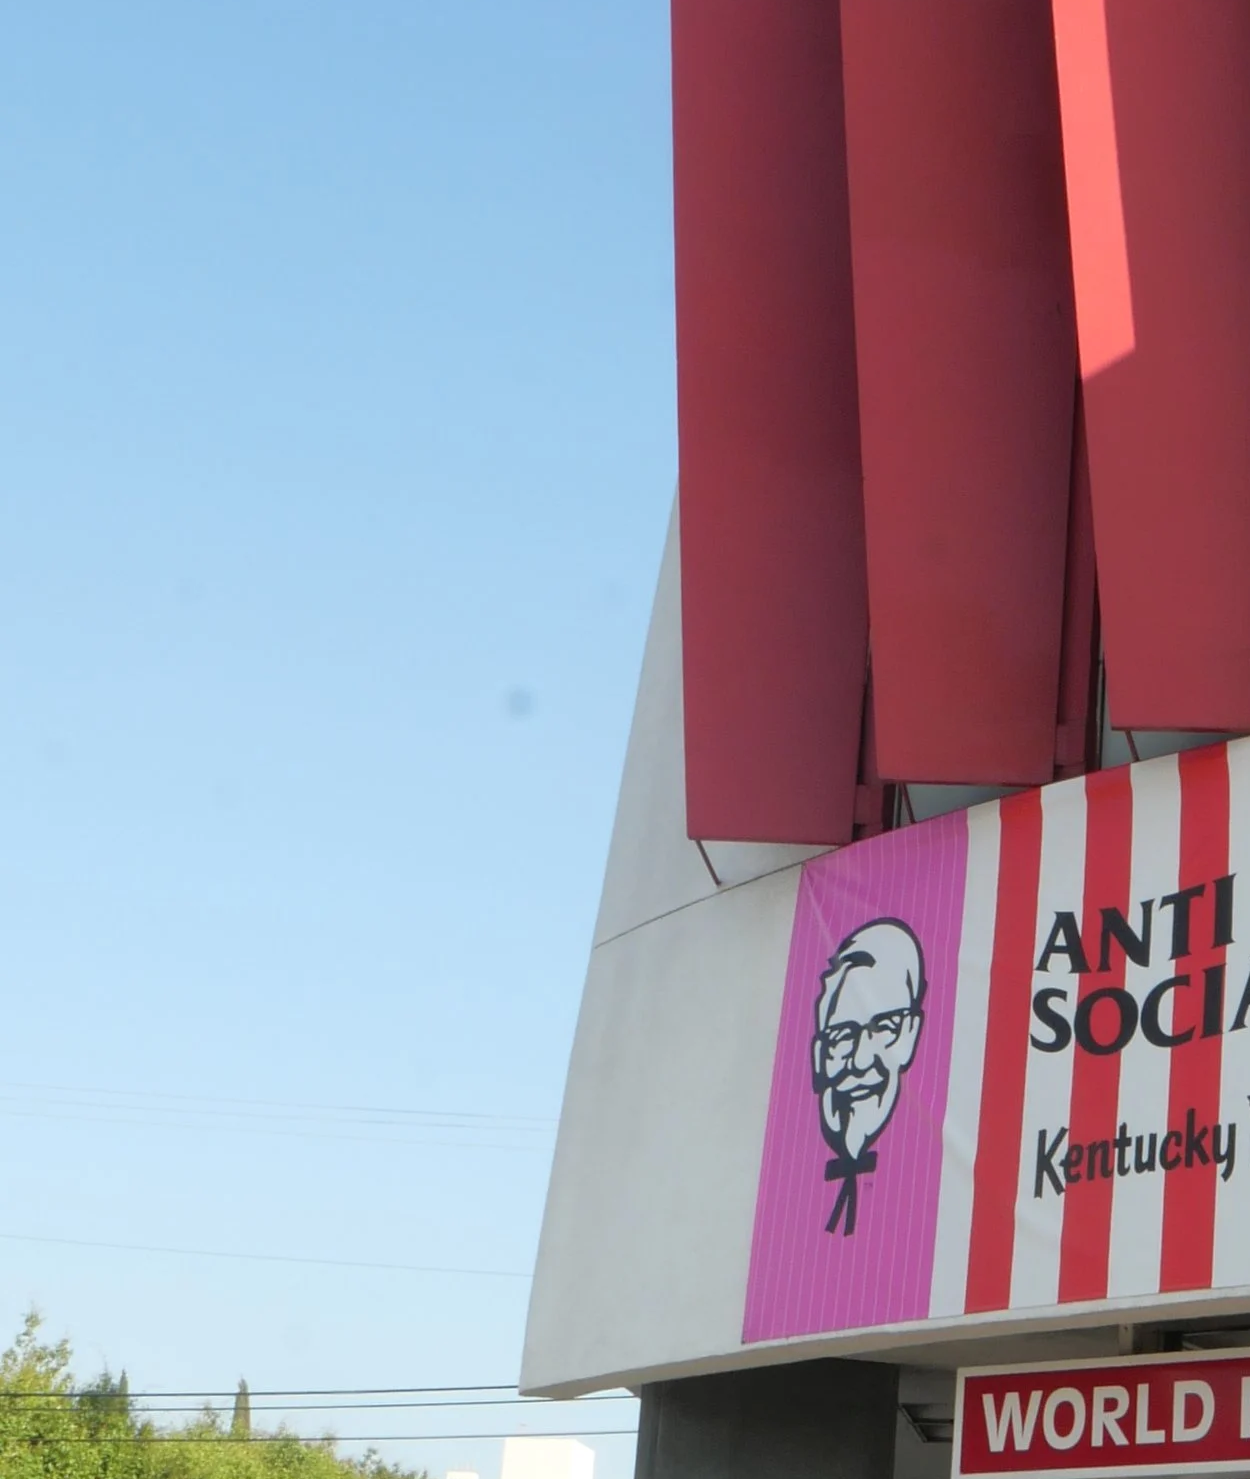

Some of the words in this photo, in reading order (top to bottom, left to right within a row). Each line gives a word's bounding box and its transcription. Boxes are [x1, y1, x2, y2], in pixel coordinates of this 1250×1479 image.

[1035, 872, 1237, 974] ANTI
[1033, 1110, 1238, 1199] Kentucky
[983, 1380, 1215, 1453] WORLD
